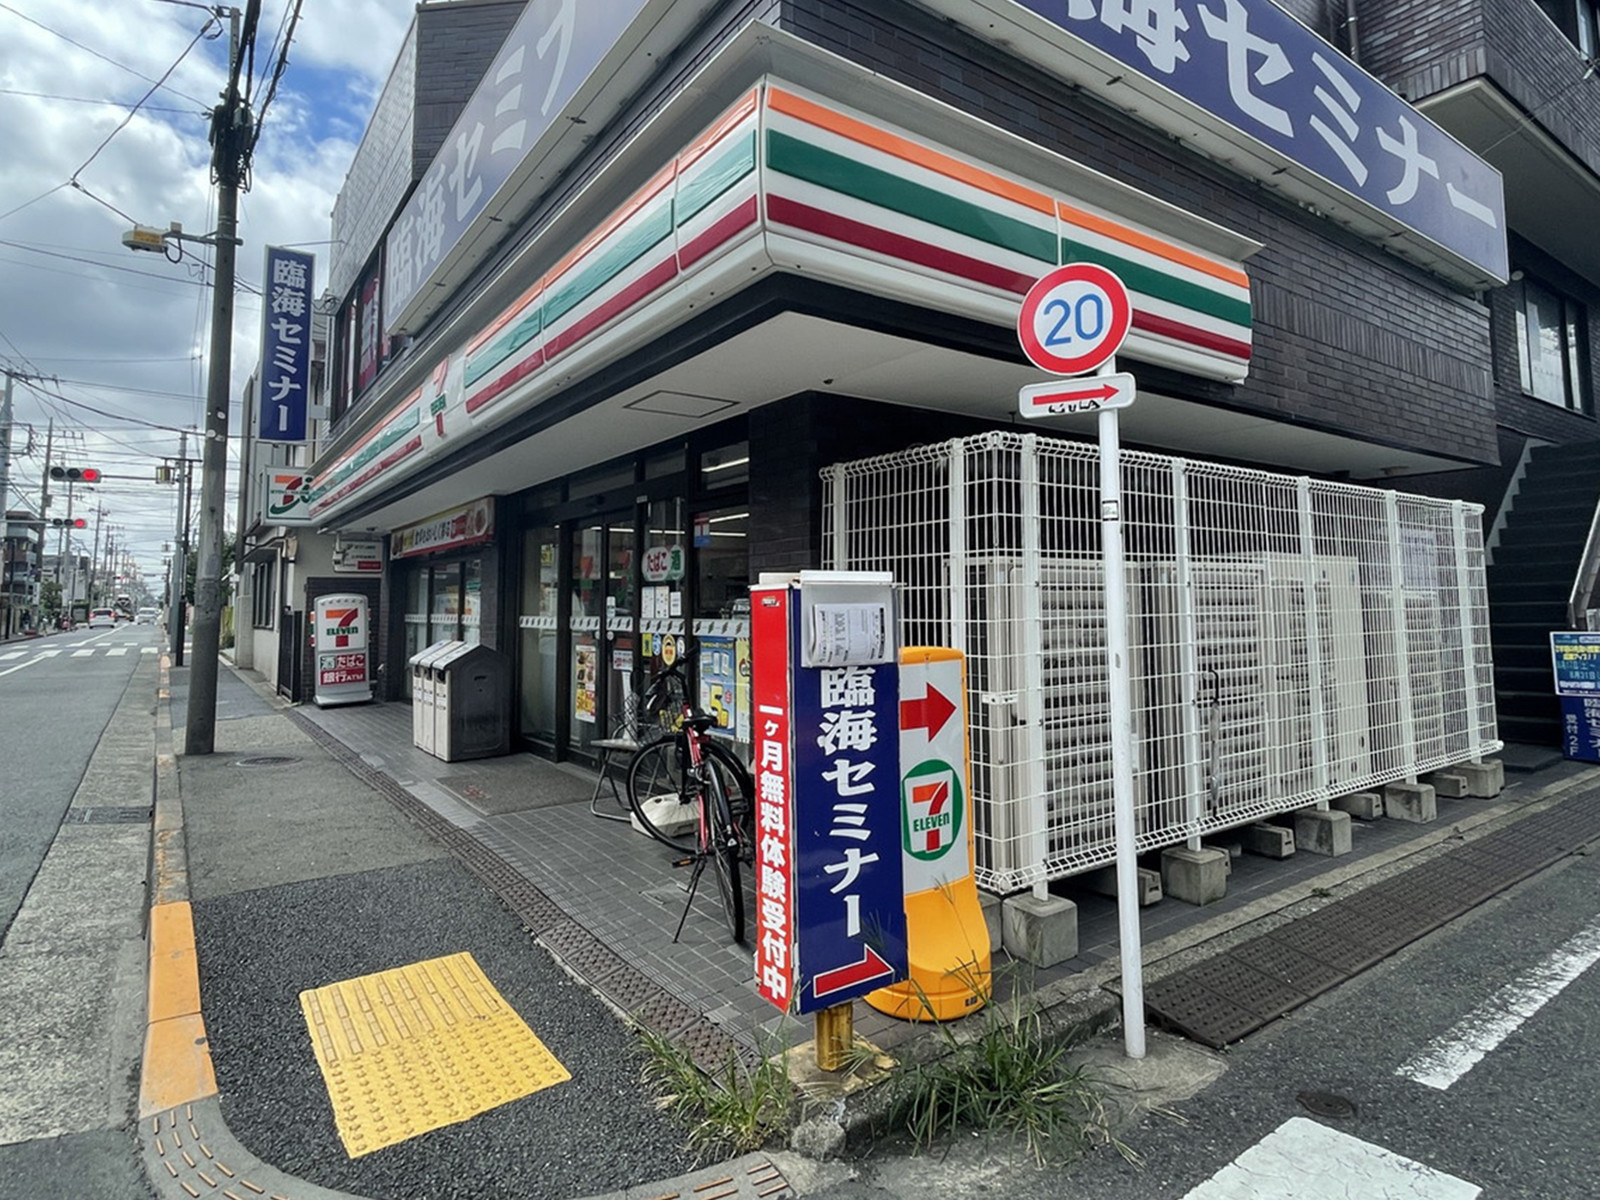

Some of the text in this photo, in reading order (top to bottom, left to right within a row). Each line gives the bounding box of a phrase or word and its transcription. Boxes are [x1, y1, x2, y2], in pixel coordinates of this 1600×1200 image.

[268, 258, 307, 432] 臨海セミナー
[1043, 293, 1104, 347] 20
[646, 551, 668, 572] たばこ
[325, 608, 358, 647] 7
[322, 670, 364, 684] 銀行ATM
[336, 654, 365, 669] たばこ
[817, 666, 879, 938] 臨海セミナー
[912, 781, 949, 852] 7
[759, 704, 787, 1000] 一ヶ月無料体験受付中
